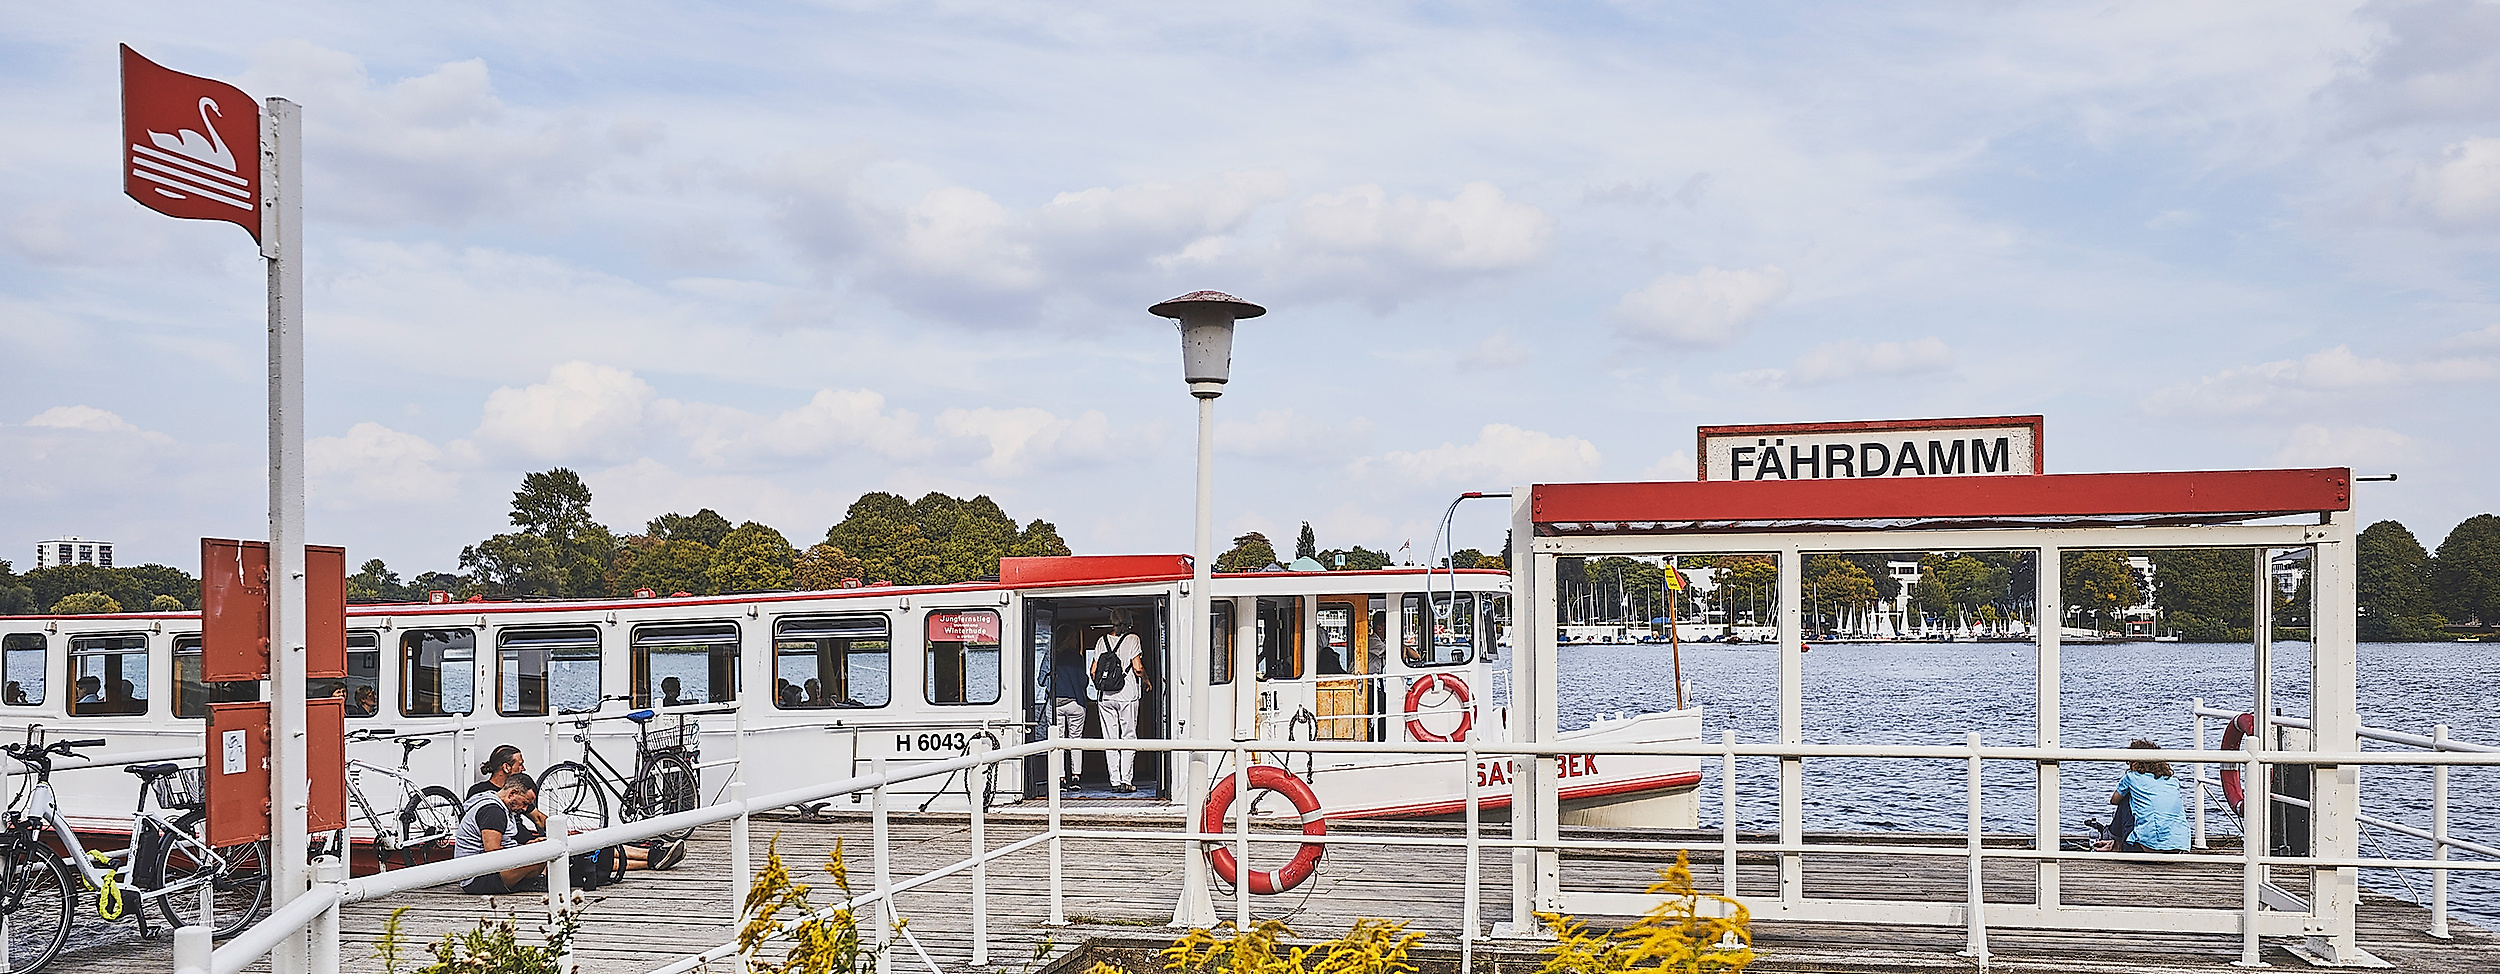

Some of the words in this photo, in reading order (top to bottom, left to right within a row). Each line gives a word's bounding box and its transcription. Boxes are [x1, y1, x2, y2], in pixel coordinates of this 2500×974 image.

[1731, 437, 2010, 481] FÄHRDAMM
[896, 734, 911, 752] H
[917, 732, 966, 752] 6043
